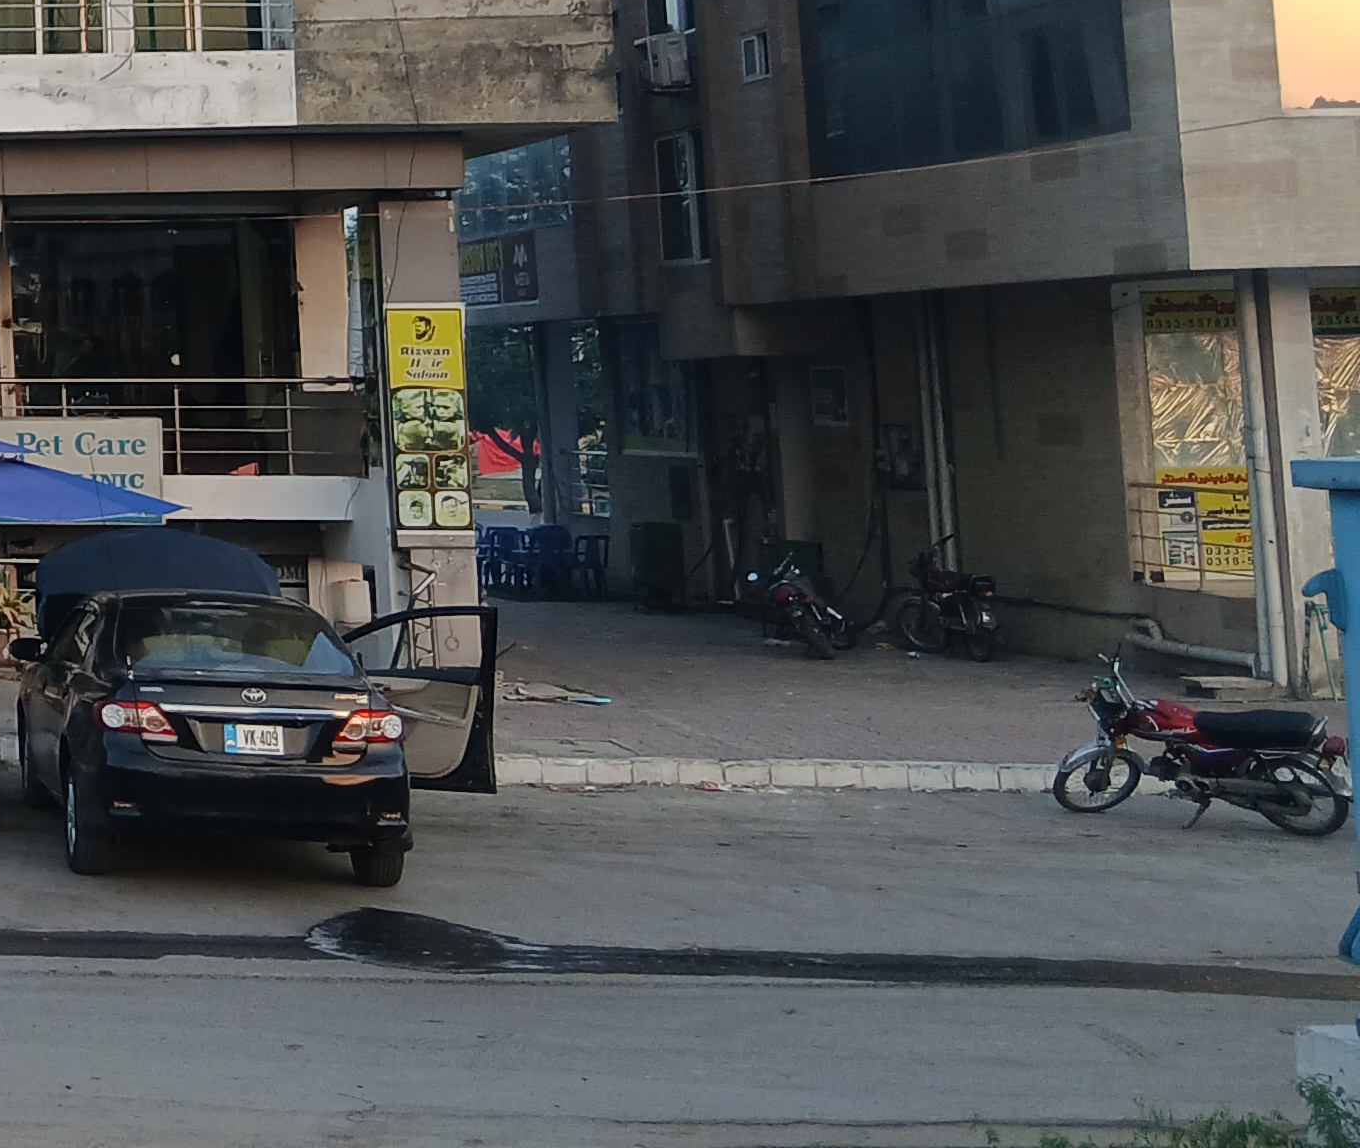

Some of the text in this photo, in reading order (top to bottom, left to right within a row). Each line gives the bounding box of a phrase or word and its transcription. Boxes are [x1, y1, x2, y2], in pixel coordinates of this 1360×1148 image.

[400, 346, 451, 357] Rizwan
[410, 357, 443, 368] Hir
[16, 432, 64, 458] Pet
[74, 431, 147, 457] Care
